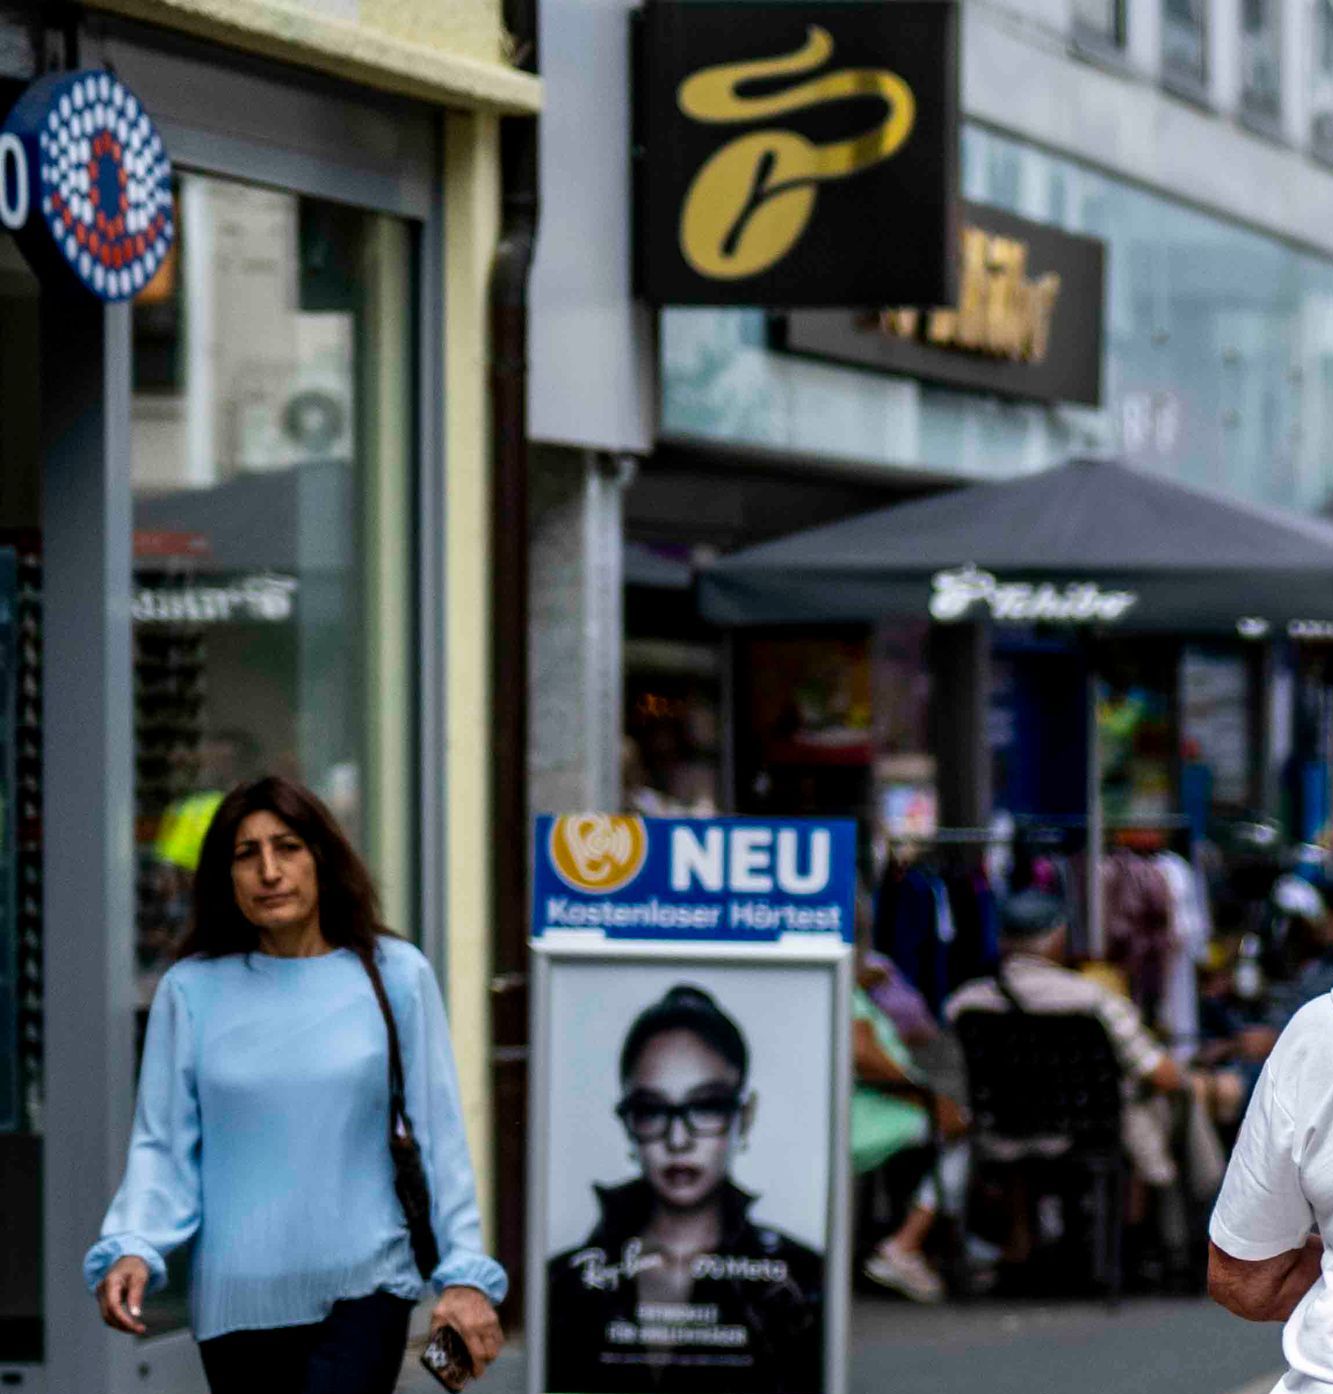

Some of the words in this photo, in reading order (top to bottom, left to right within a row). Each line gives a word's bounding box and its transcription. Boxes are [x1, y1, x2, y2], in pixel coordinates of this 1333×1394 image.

[670, 825, 831, 895] NEU
[549, 898, 721, 927] Kostenloser
[730, 901, 841, 929] Hörtest
